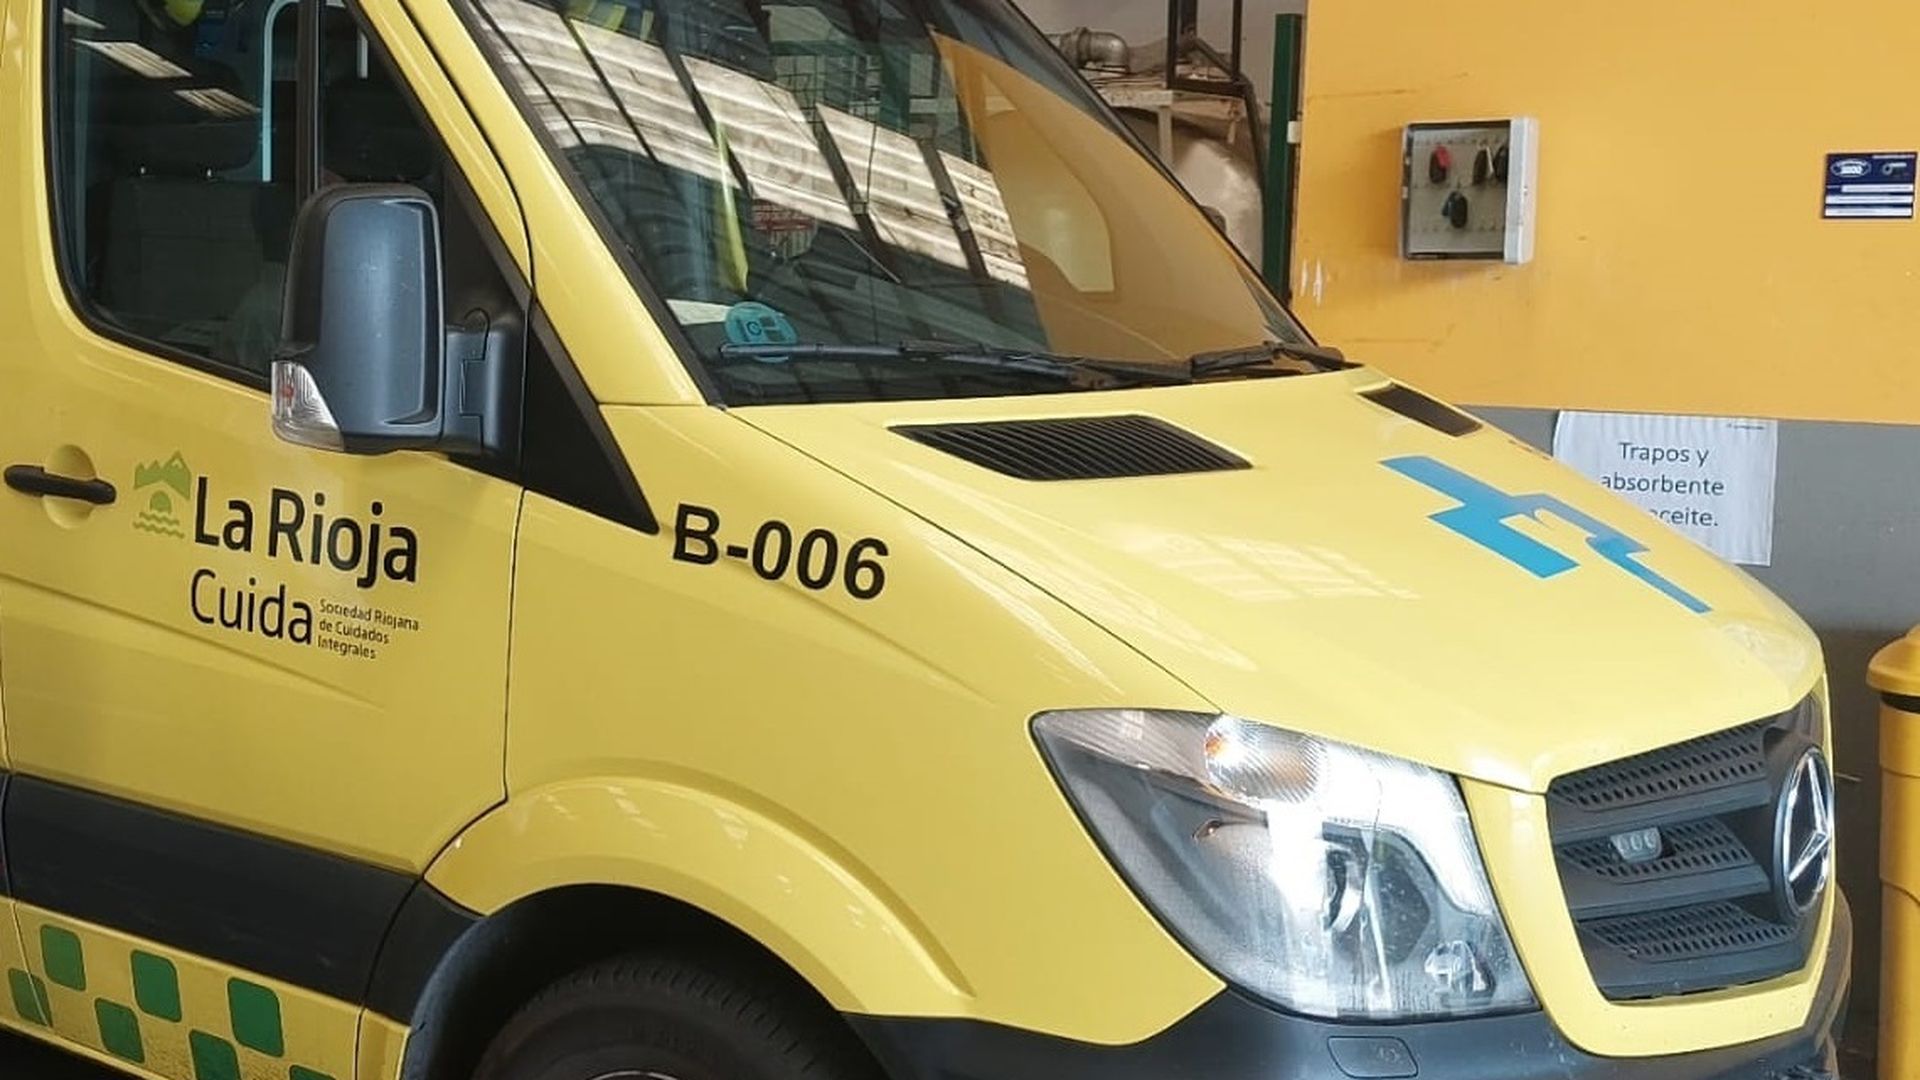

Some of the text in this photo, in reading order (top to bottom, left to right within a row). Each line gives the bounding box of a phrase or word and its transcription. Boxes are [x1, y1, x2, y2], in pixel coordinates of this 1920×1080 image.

[1619, 442, 1709, 467] Trapos y
[1601, 471, 1724, 495] absorbente
[1649, 507, 1718, 526] ceite.
[194, 476, 418, 589] La Rioja
[672, 503, 889, 599] B-006
[190, 568, 312, 645] Cuida
[320, 598, 419, 631] Sociedad Riojana
[320, 619, 389, 644] de Cuidados
[318, 635, 376, 659] Integrales
